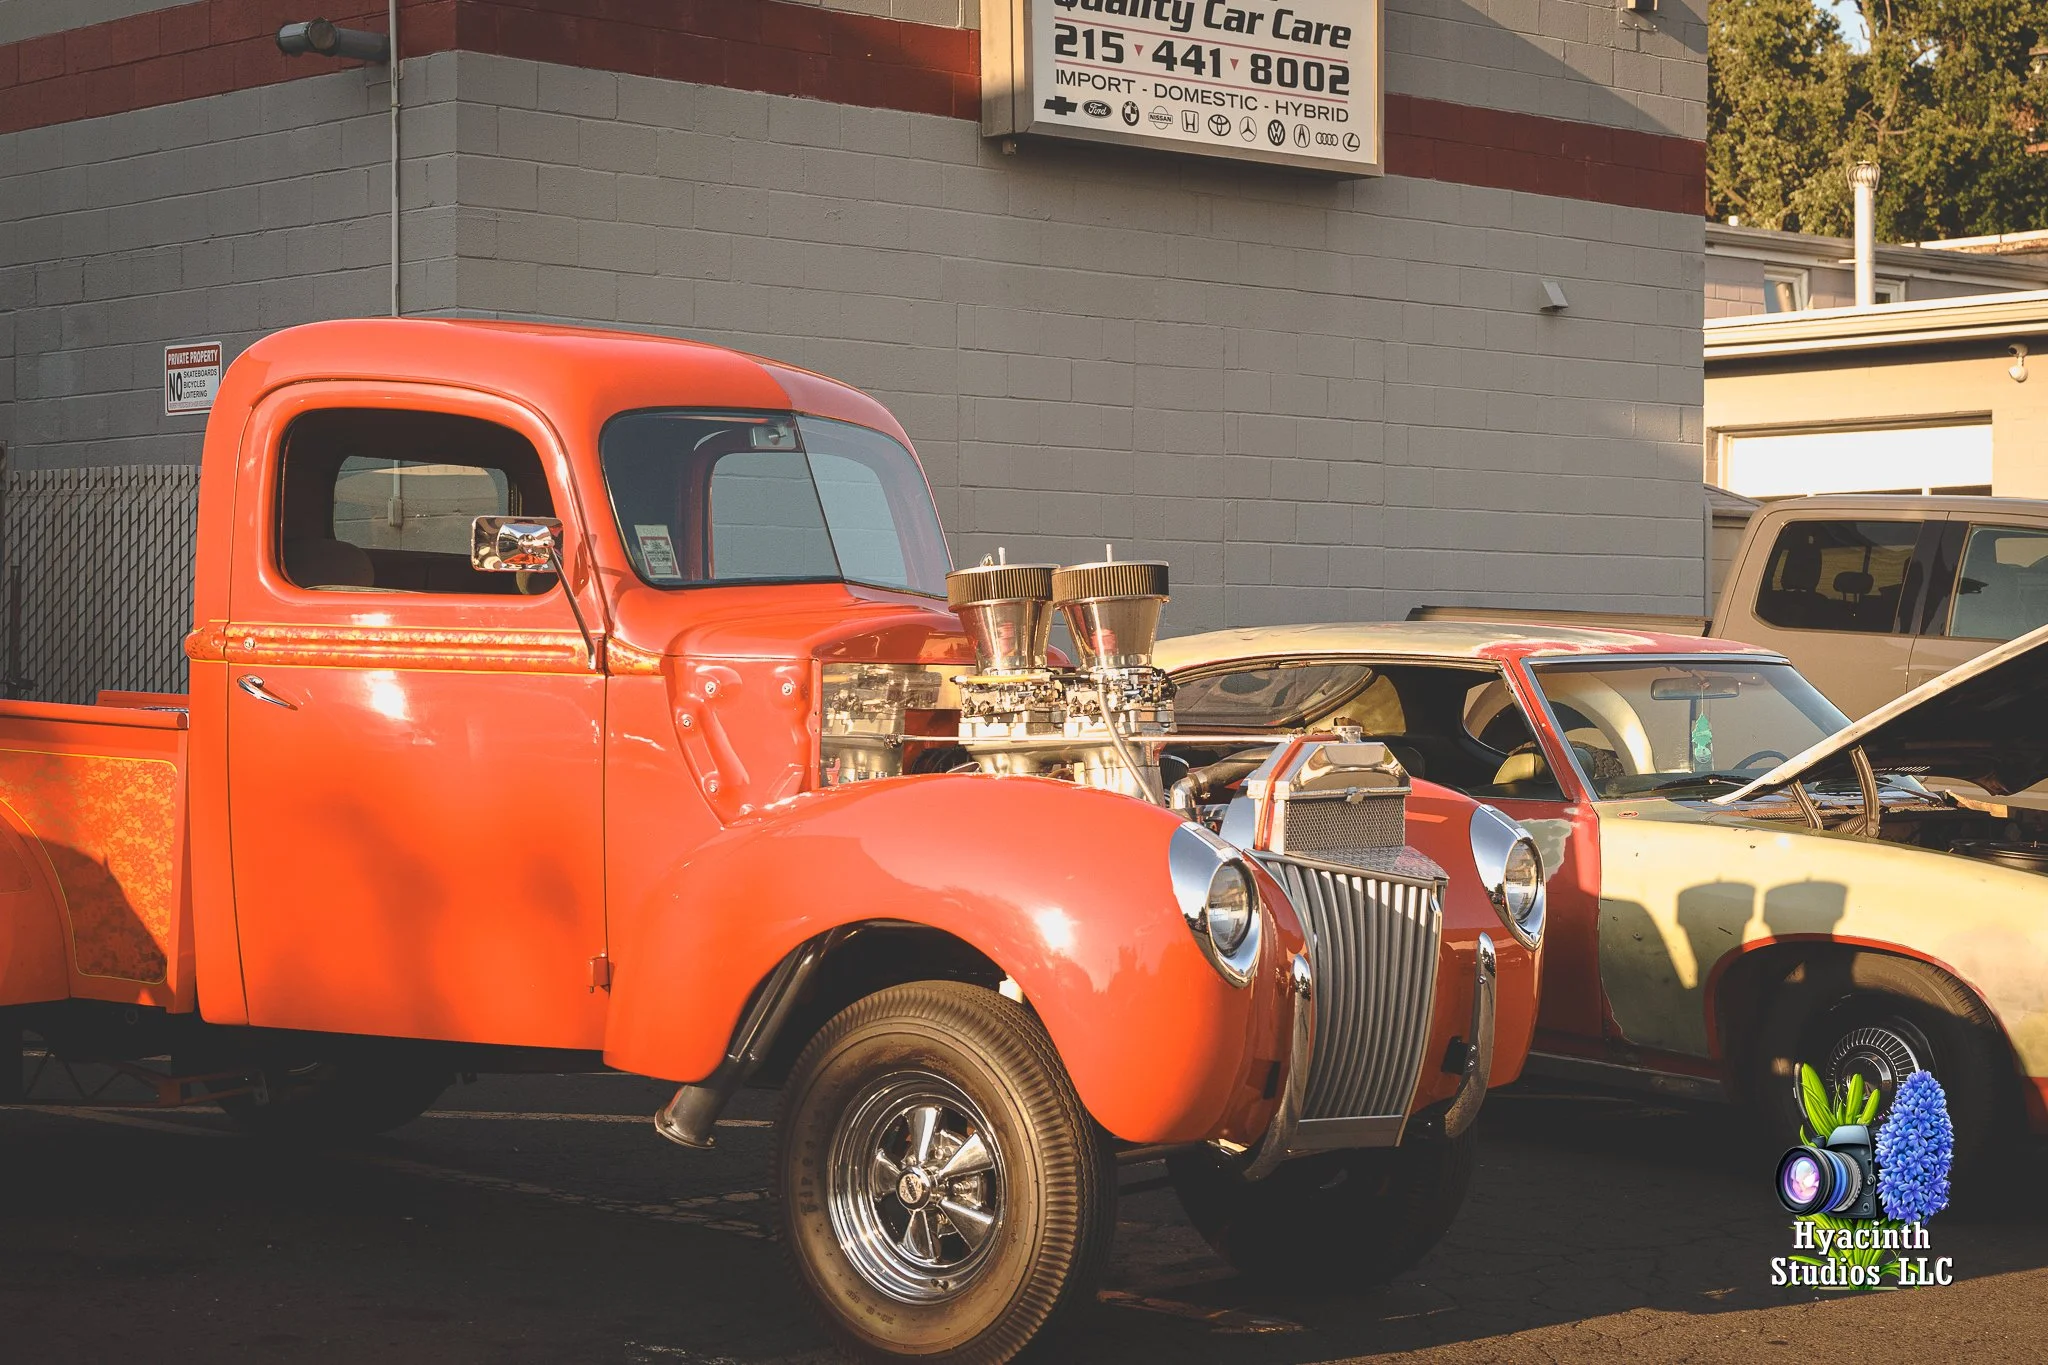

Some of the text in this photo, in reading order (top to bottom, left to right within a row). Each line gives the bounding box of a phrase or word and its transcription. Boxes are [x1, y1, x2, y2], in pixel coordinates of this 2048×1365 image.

[1203, 0, 1264, 35] Car
[1272, 8, 1352, 50] Care
[1054, 23, 1350, 96] 215 441 8002
[1055, 68, 1136, 95] IMPORT
[1154, 82, 1258, 112] DOMESTIC
[1275, 99, 1349, 123] HYBRID
[1088, 102, 1108, 116] Ford
[1149, 113, 1172, 123] NISSAN
[168, 349, 219, 366] PRIVATE PROPERTY
[183, 368, 218, 379] SKATEBOARDS
[183, 379, 206, 389] BICYCLES
[169, 371, 183, 402] NO
[183, 389, 208, 400] LOITERING
